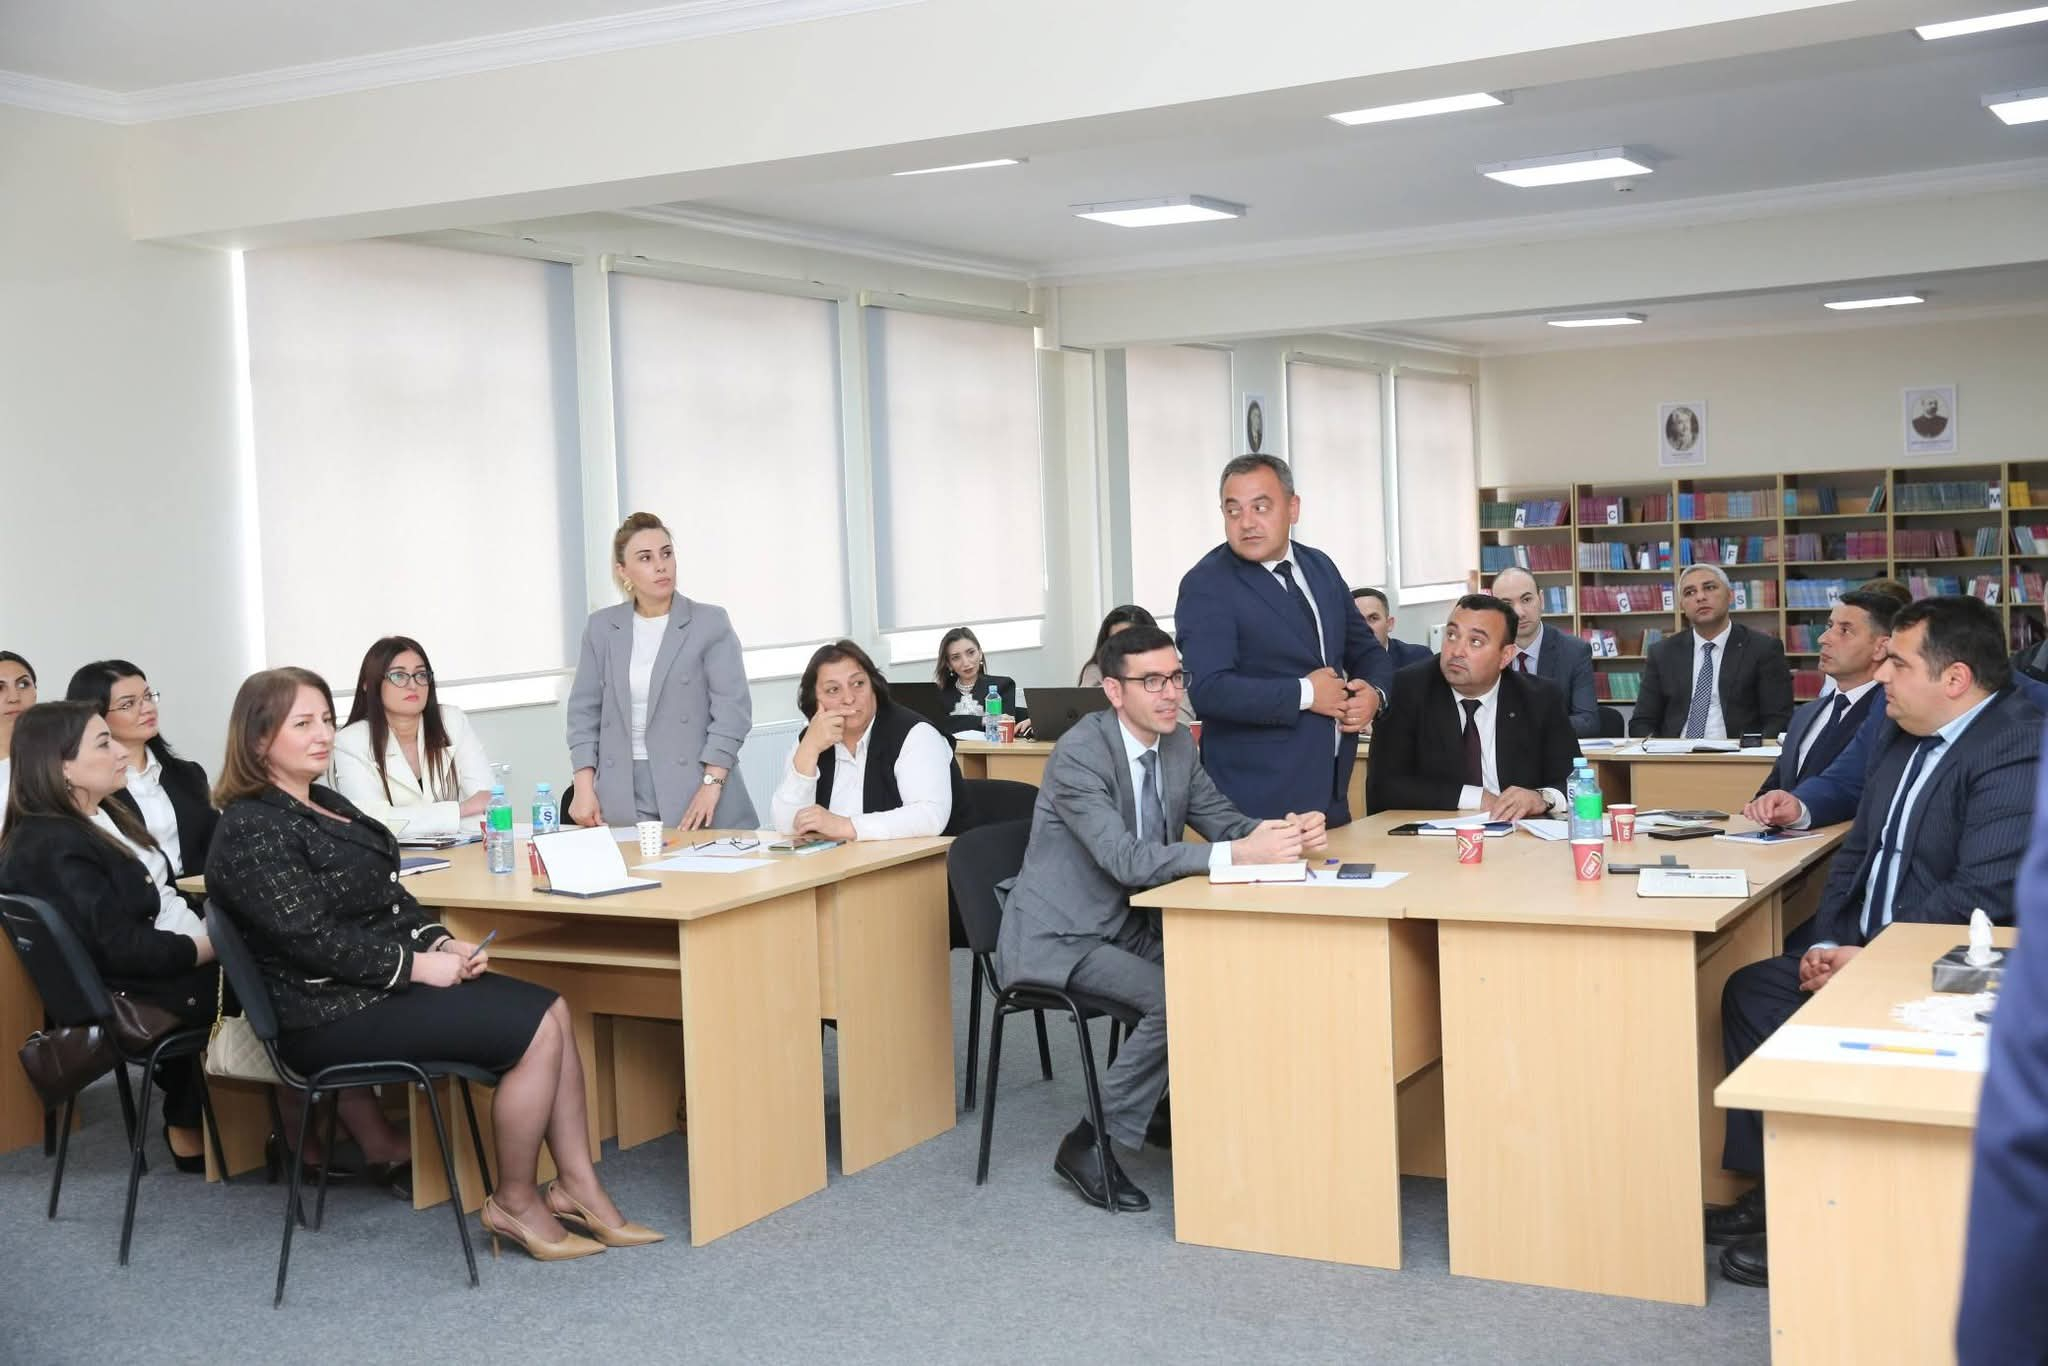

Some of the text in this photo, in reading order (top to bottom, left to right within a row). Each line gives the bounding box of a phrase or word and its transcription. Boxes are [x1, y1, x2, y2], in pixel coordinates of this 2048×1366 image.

[1990, 493, 2001, 502] M
[1516, 513, 1524, 522] A
[1608, 510, 1617, 520] C
[1727, 550, 1735, 560] F
[1988, 589, 1996, 599] X
[1664, 596, 1672, 606] E
[1593, 641, 1601, 652] D
[1608, 642, 1616, 652] Z
